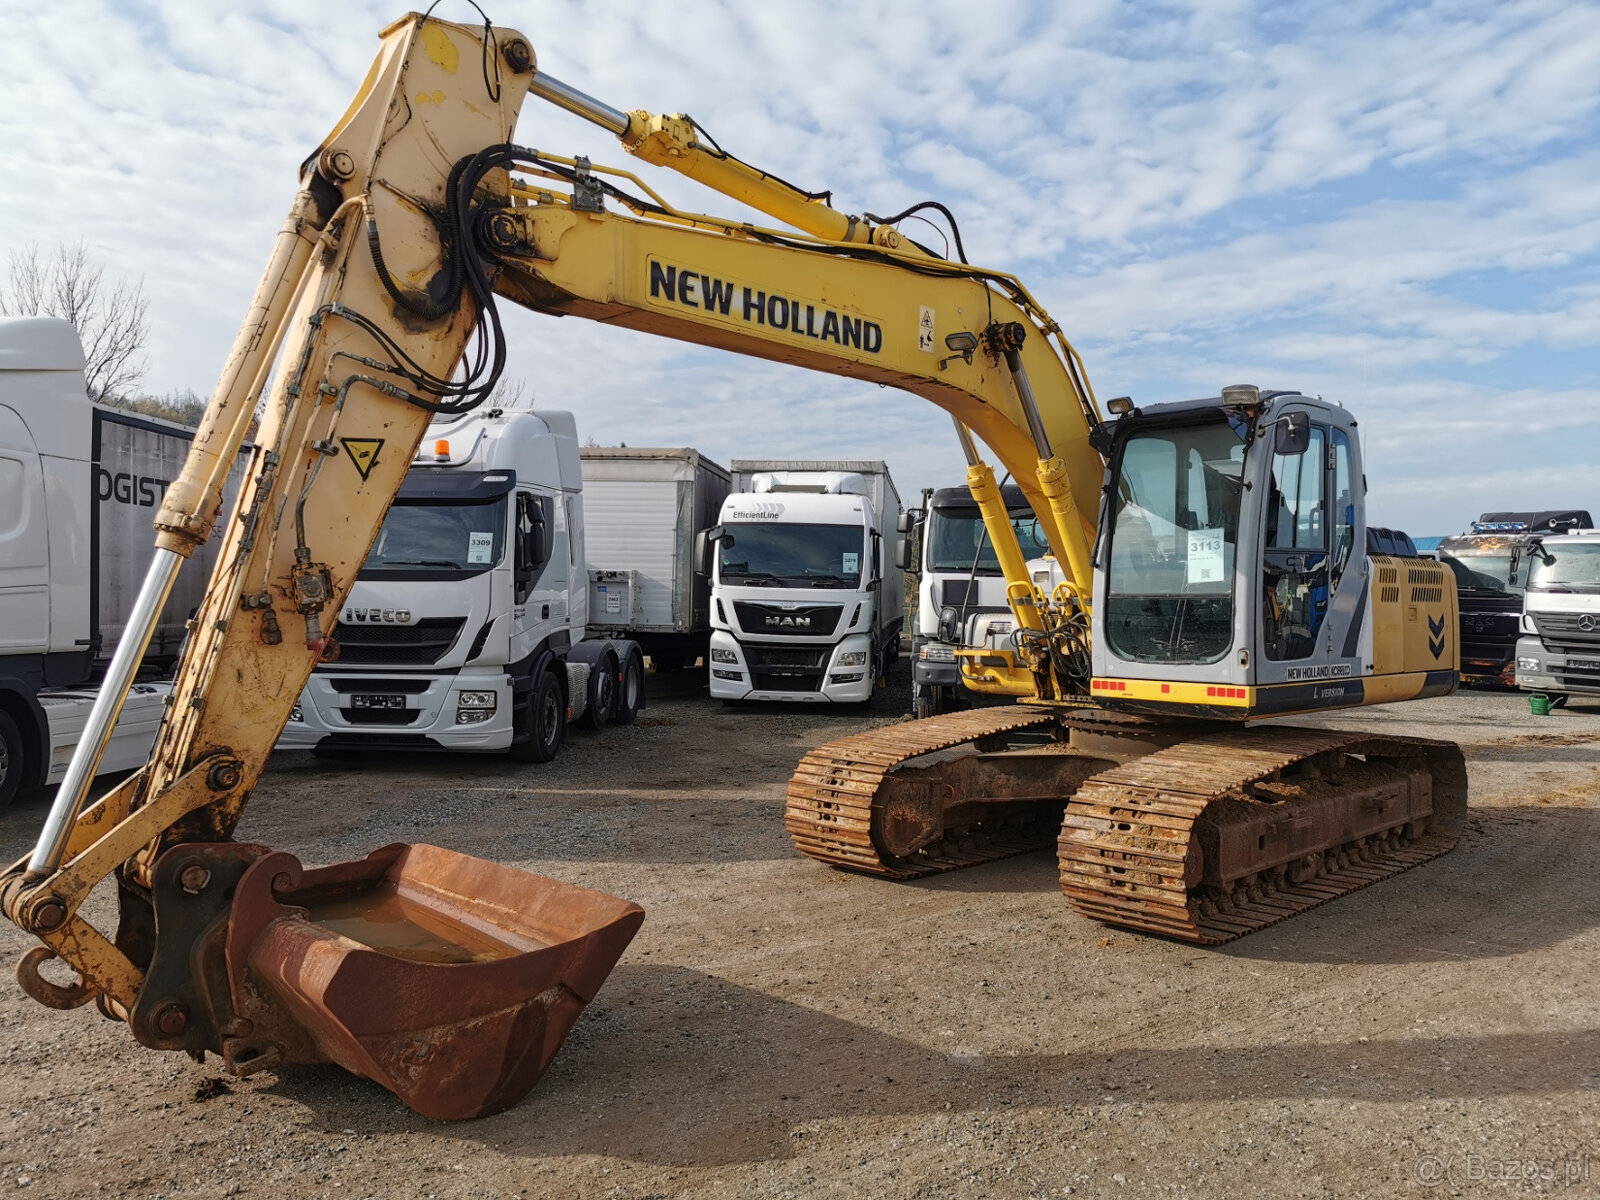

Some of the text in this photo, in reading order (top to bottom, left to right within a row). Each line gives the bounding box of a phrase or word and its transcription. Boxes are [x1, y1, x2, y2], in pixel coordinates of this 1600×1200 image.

[650, 259, 882, 354] NEW HOLLAND
[733, 511, 780, 519] EfficientLine
[1191, 541, 1221, 552] 3113
[346, 608, 411, 622] IVECO
[765, 616, 811, 628] MAN
[1287, 664, 1351, 680] NEW HOLLAND KOBELCO
[1313, 687, 1345, 699] L VERSION
